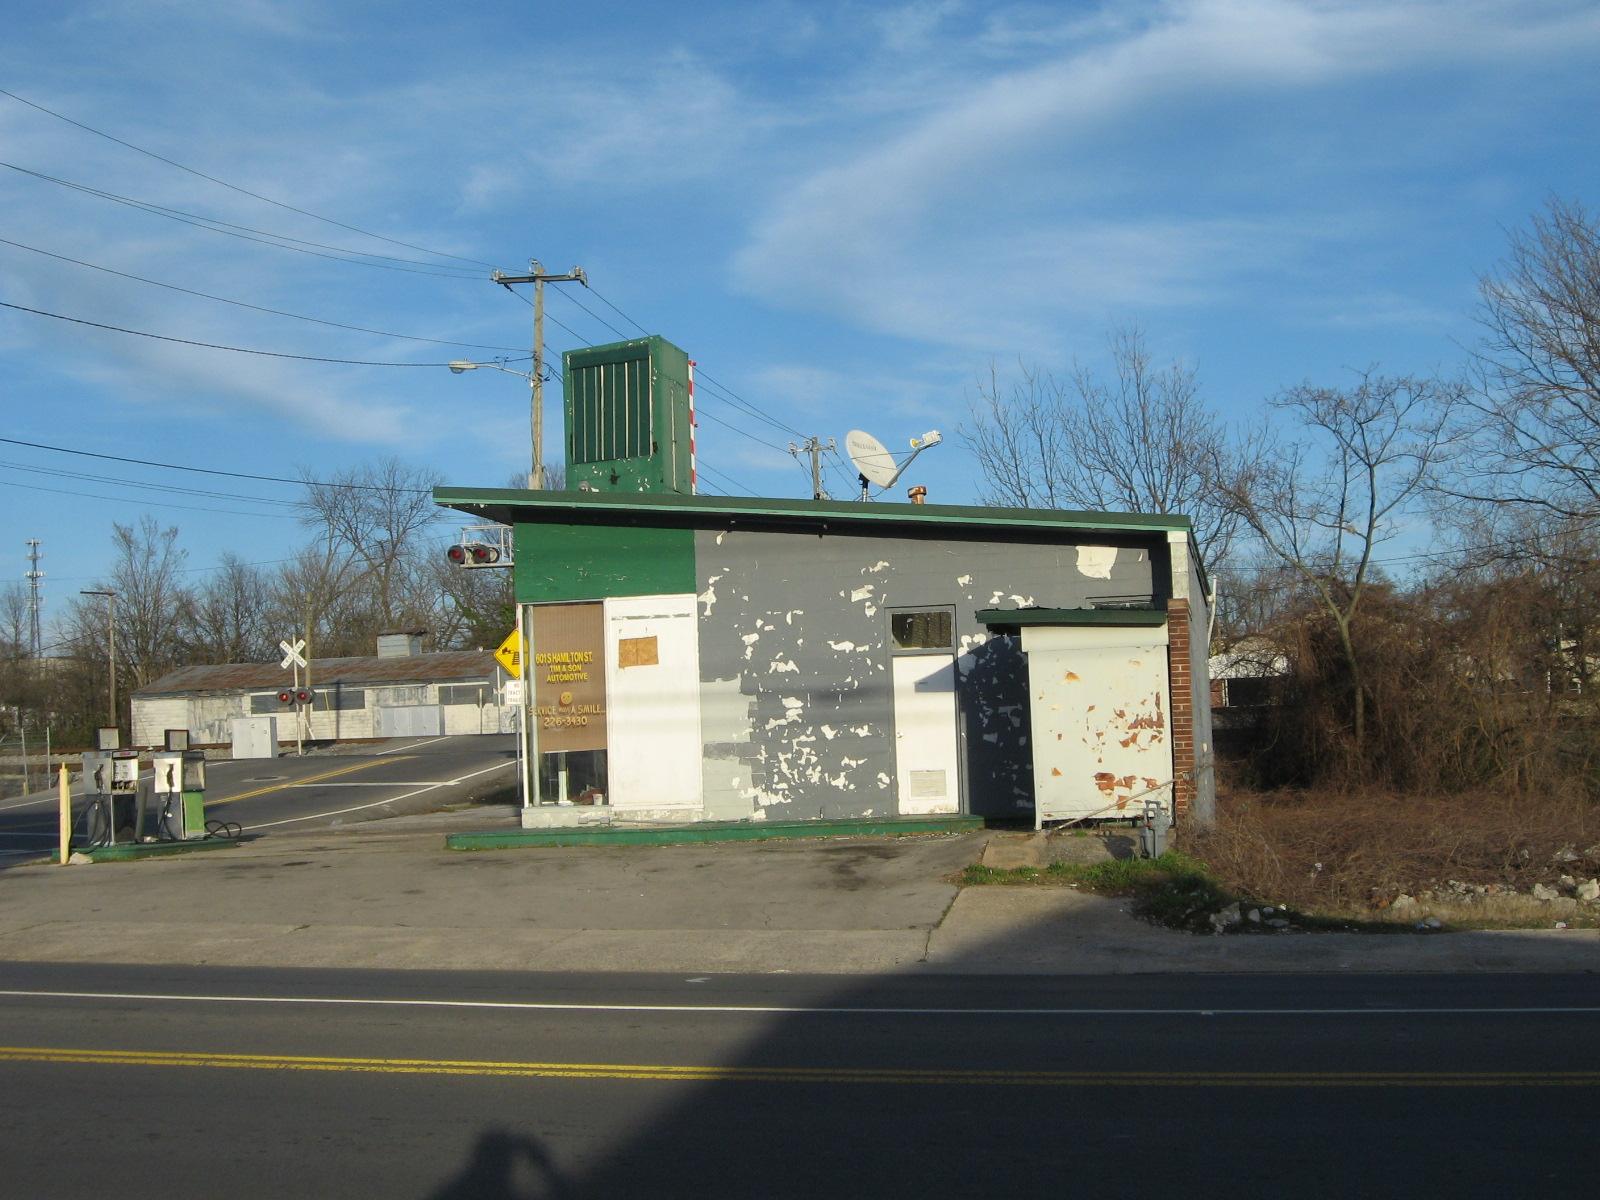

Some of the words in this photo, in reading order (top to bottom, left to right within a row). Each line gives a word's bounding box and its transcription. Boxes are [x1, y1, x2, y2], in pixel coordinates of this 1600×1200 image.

[552, 651, 583, 663] HAMILTON
[567, 664, 582, 672] SON
[546, 672, 588, 682] AUTOMOTIVE
[544, 716, 588, 727] 226-3430
